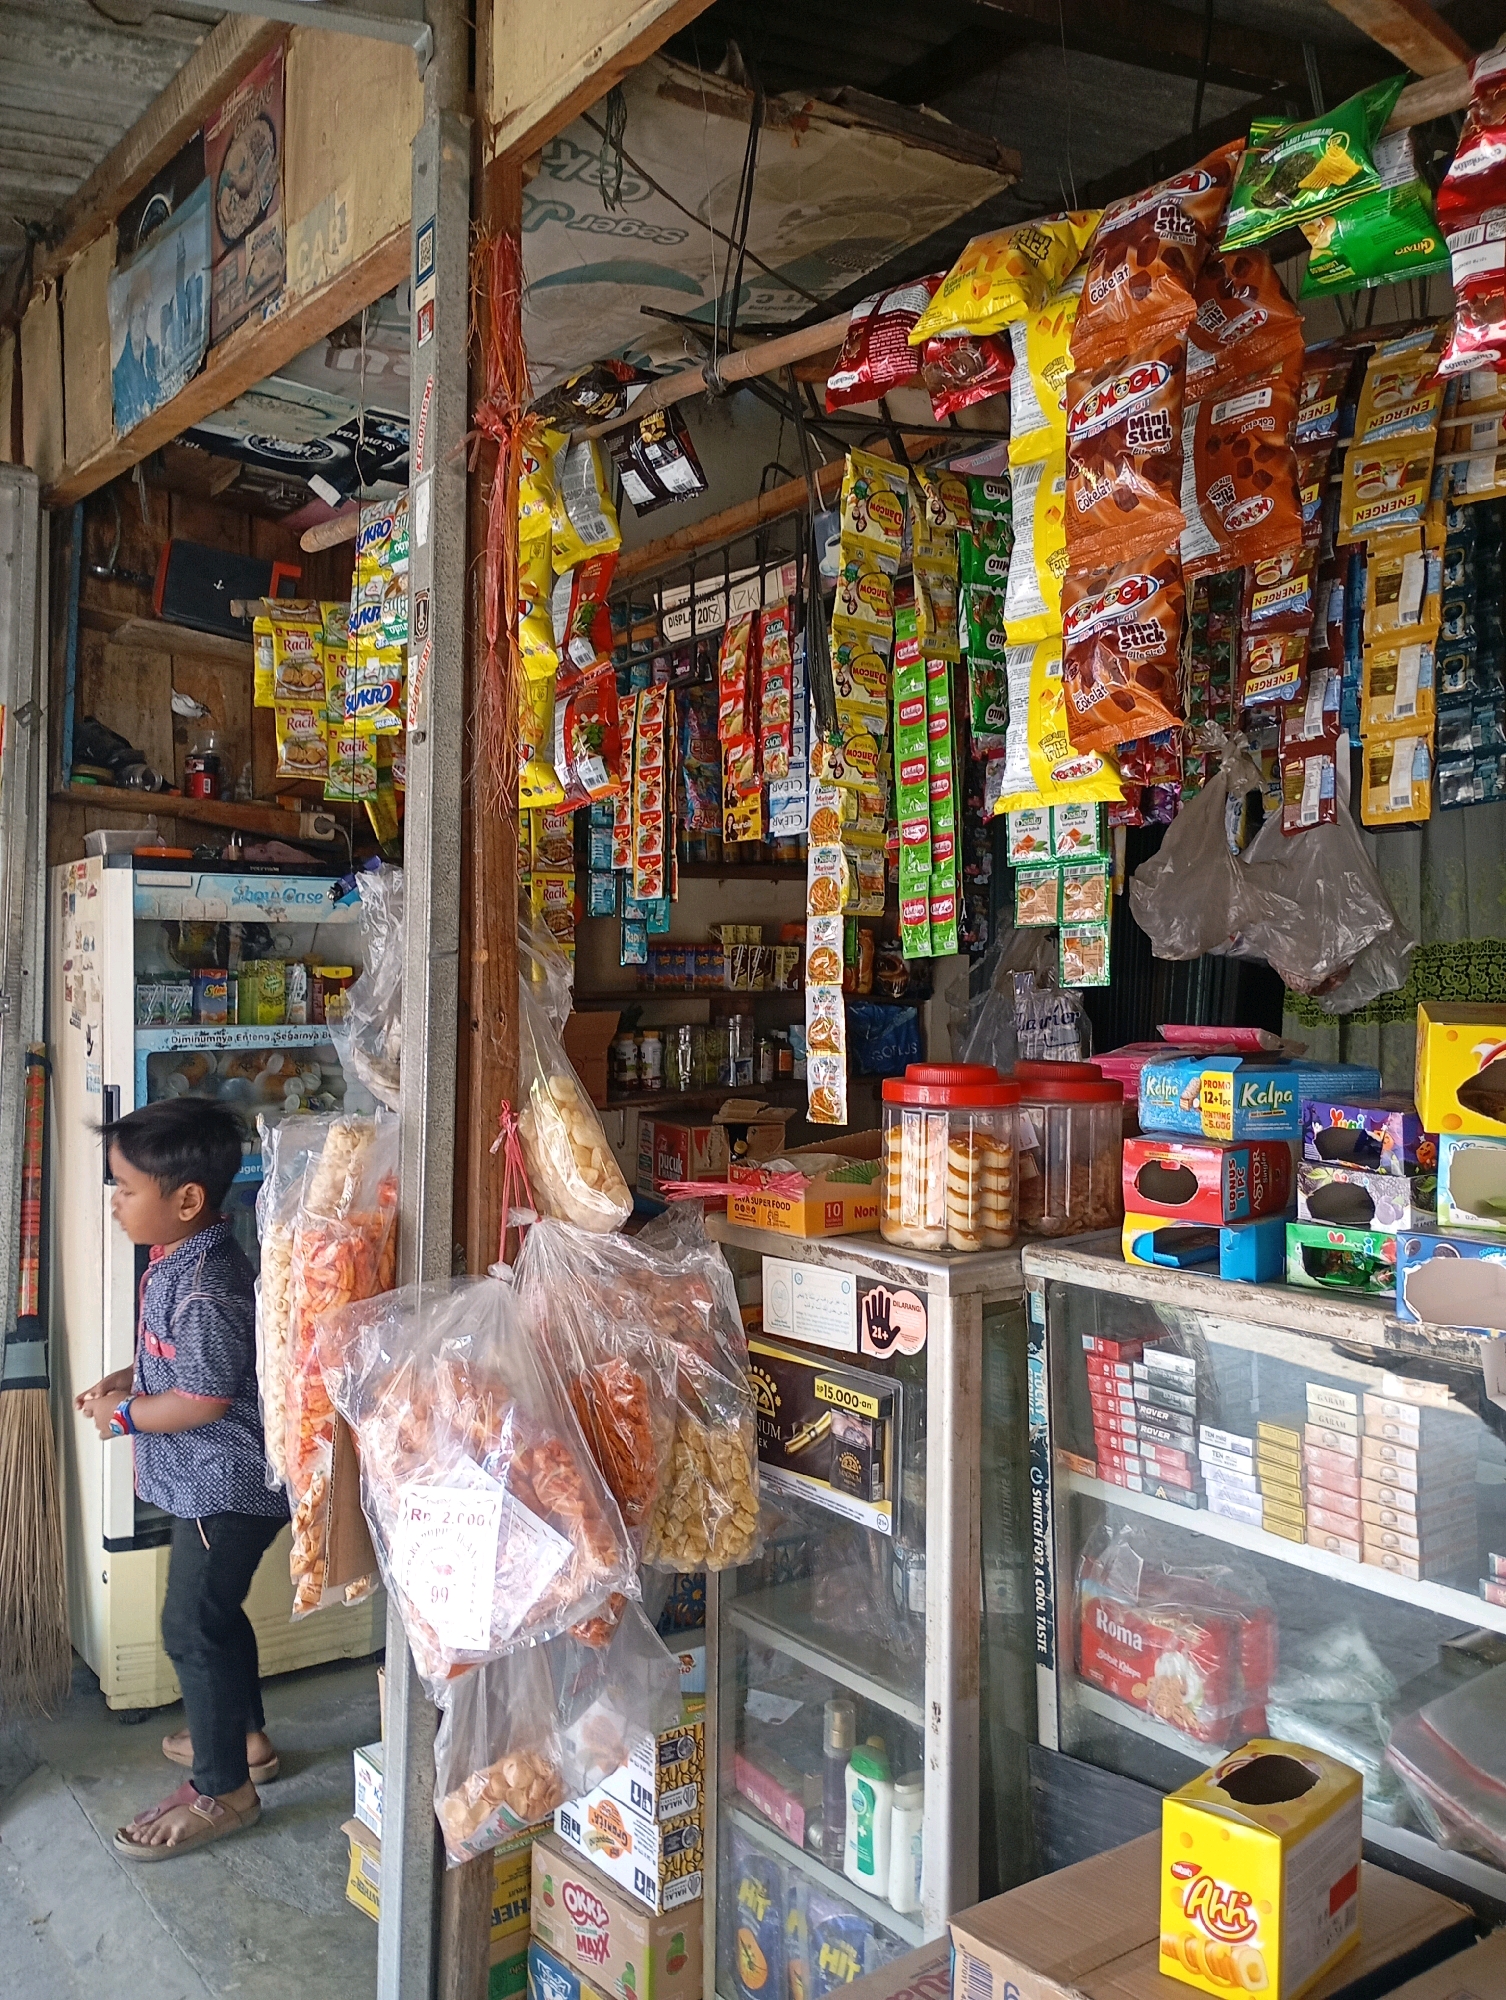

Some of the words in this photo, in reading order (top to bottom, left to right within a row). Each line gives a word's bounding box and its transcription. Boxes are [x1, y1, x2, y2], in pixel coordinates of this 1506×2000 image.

[1090, 265, 1130, 304] Cokelat
[1129, 410, 1169, 431] Mini
[1369, 400, 1430, 429] ENERGEN
[1127, 424, 1173, 446] Stick
[986, 484, 1009, 497] MILO
[1077, 480, 1113, 512] Cokelat
[1356, 494, 1417, 520] ENERGEN
[1255, 583, 1304, 606] ENERGEN
[349, 603, 382, 632] SUKR
[668, 612, 694, 629] DISPLA
[1119, 619, 1160, 637] Mini
[283, 638, 315, 651] Racik
[1120, 630, 1167, 651] Stick
[1246, 671, 1294, 693] ENERGEN
[345, 683, 392, 715] SUKRO
[1074, 685, 1109, 713] Cokelat
[286, 717, 318, 731] Racik
[988, 709, 1006, 721] MILO
[337, 740, 368, 754] Racik
[772, 779, 803, 794] CLEAR
[541, 817, 569, 832] Racik
[772, 813, 803, 828] CLEAR
[233, 884, 282, 907] Show
[286, 887, 324, 906] Case
[543, 886, 569, 901] Racik
[171, 1035, 233, 1045] Diminumnya
[1146, 1075, 1179, 1100] Kalpa
[1241, 1080, 1293, 1111] Kalpa
[1203, 1080, 1231, 1090] PROMO
[658, 1153, 683, 1178] pucuk
[1236, 1164, 1246, 1187] PC
[1227, 1158, 1237, 1213] BONUS
[1252, 1148, 1262, 1211] ASTOR
[750, 1196, 771, 1208] SUPER
[771, 1200, 791, 1211] FOOD
[826, 1203, 841, 1218] 10
[854, 1205, 878, 1219] Nori
[892, 1299, 922, 1313] DILARANG!
[872, 1325, 889, 1341] 21+
[1033, 1369, 1046, 1417] LUCKY
[1317, 1393, 1345, 1408] GARAM
[1140, 1404, 1169, 1421] ROVER
[1318, 1414, 1346, 1430] GARAM
[1140, 1424, 1171, 1441] ROVER
[1032, 1487, 1044, 1538] SWITCH
[1033, 1538, 1045, 1565] FOR
[1034, 1577, 1046, 1612] COOL
[1035, 1614, 1048, 1653] TASTE
[1096, 1607, 1143, 1651] Roma
[661, 1798, 683, 1813] HALAL
[665, 1887, 688, 1902] HALAL
[565, 1886, 609, 1926] OKKY
[576, 1931, 612, 1965] MAXX
